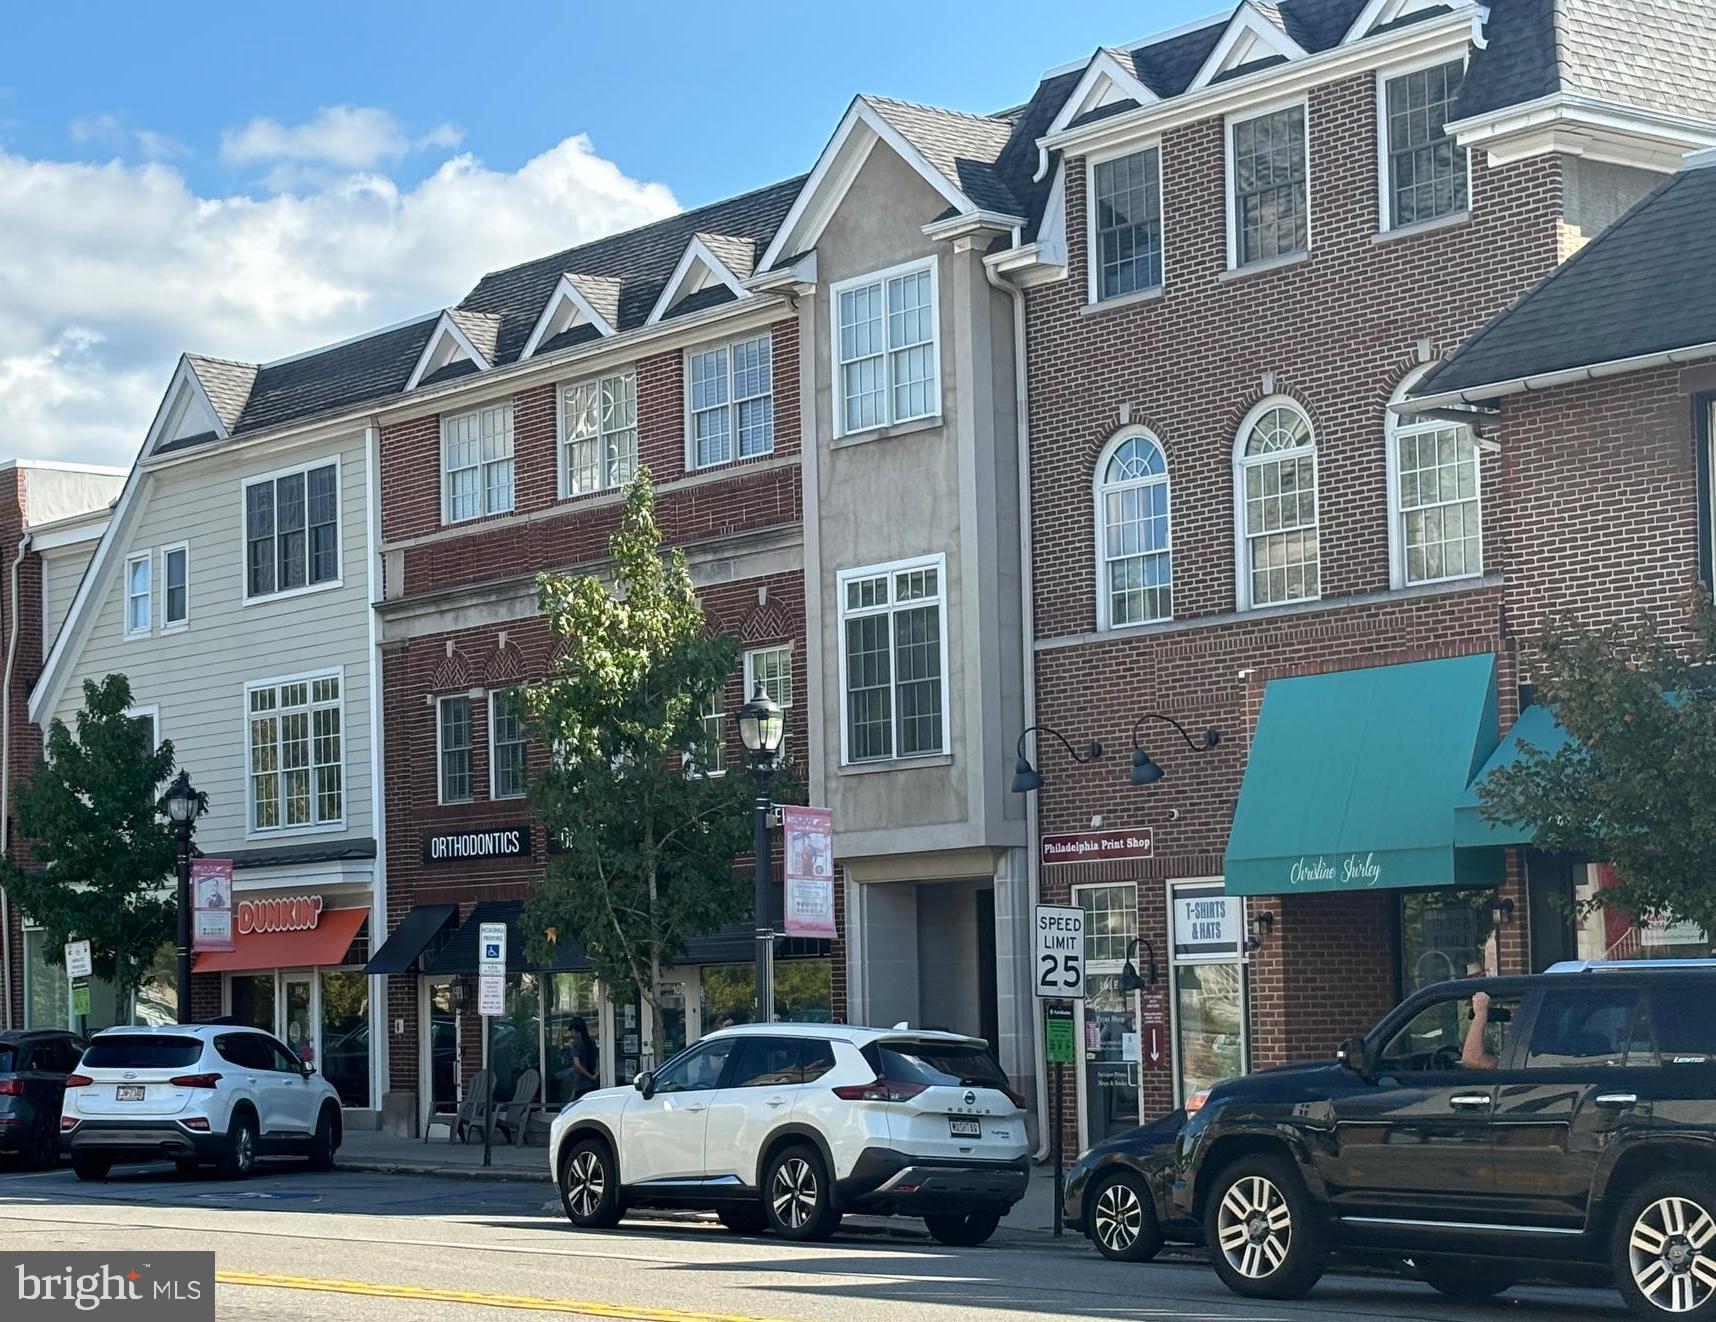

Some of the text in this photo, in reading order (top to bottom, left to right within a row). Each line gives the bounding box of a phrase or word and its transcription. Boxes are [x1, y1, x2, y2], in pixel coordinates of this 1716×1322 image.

[431, 831, 520, 858] ORTHODONTICS
[1044, 837, 1150, 854] Philadelphia Print Shop
[1290, 852, 1382, 886] Christine Shirley
[238, 895, 323, 934] DUNKIN'
[1185, 901, 1226, 920] T-SHIRTS
[1040, 916, 1082, 932] SPEED
[1192, 922, 1222, 940] & HATS
[1044, 935, 1077, 950] LIMIT
[1041, 954, 1081, 988] 25
